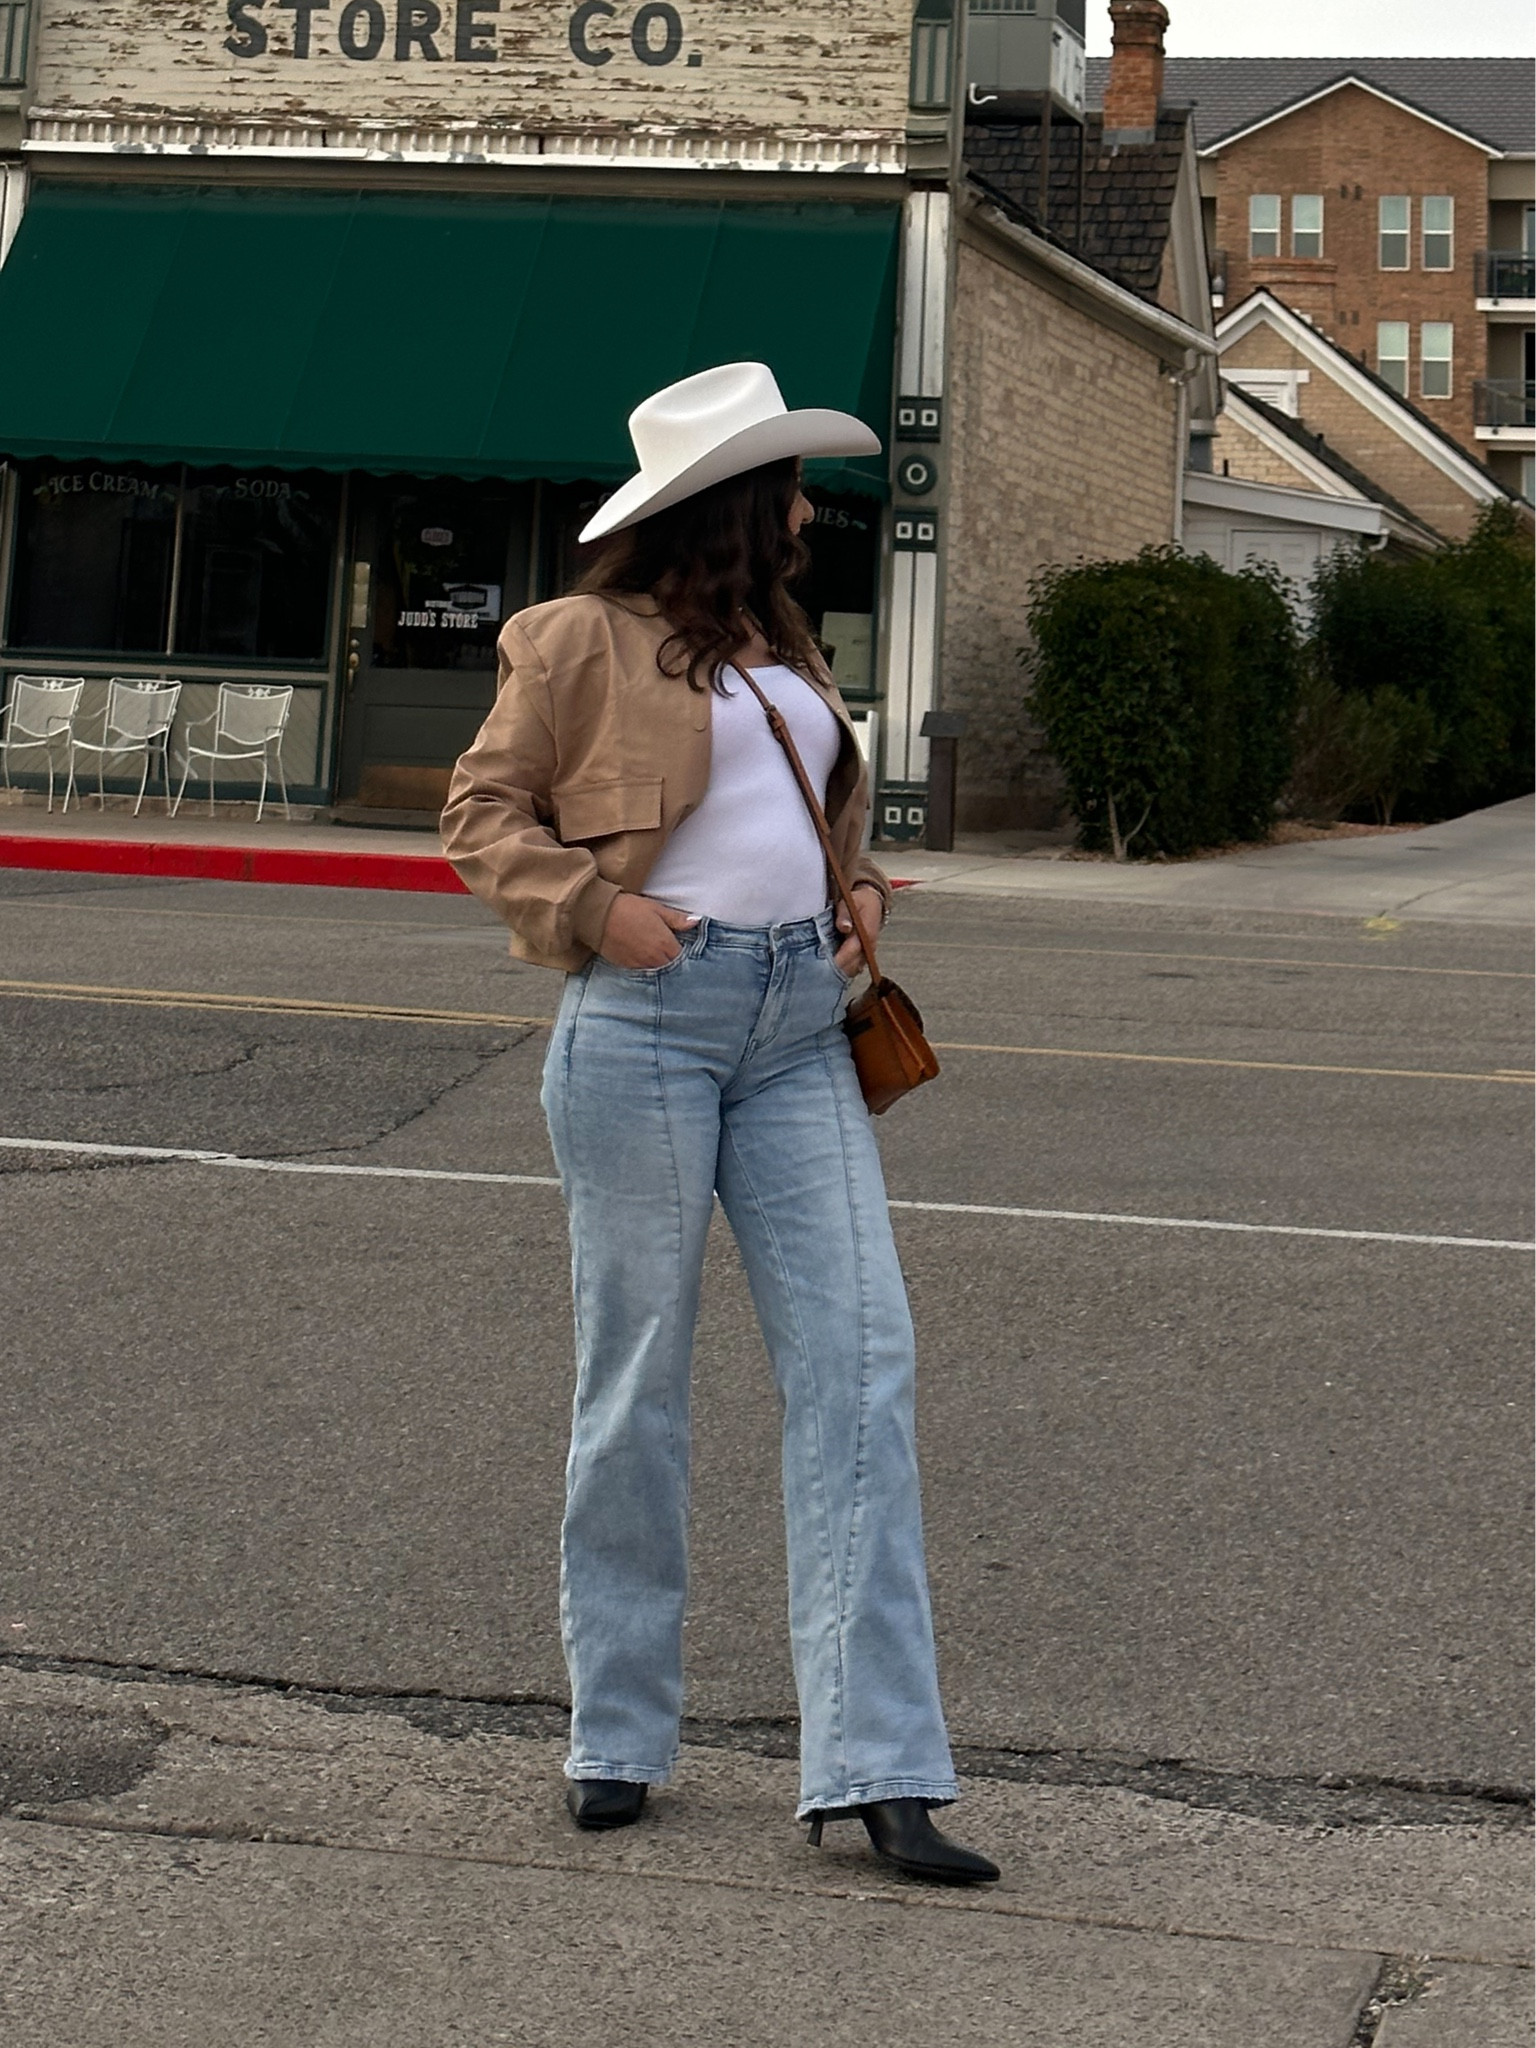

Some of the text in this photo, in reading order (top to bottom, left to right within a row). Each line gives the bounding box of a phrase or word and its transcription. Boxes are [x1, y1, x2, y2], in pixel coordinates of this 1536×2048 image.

[223, 0, 702, 67] STORE CO.
[48, 471, 159, 499] ICE CREAM
[235, 478, 291, 499] SODA
[815, 506, 850, 528] IES
[397, 609, 479, 629] JUDD'S STORE
